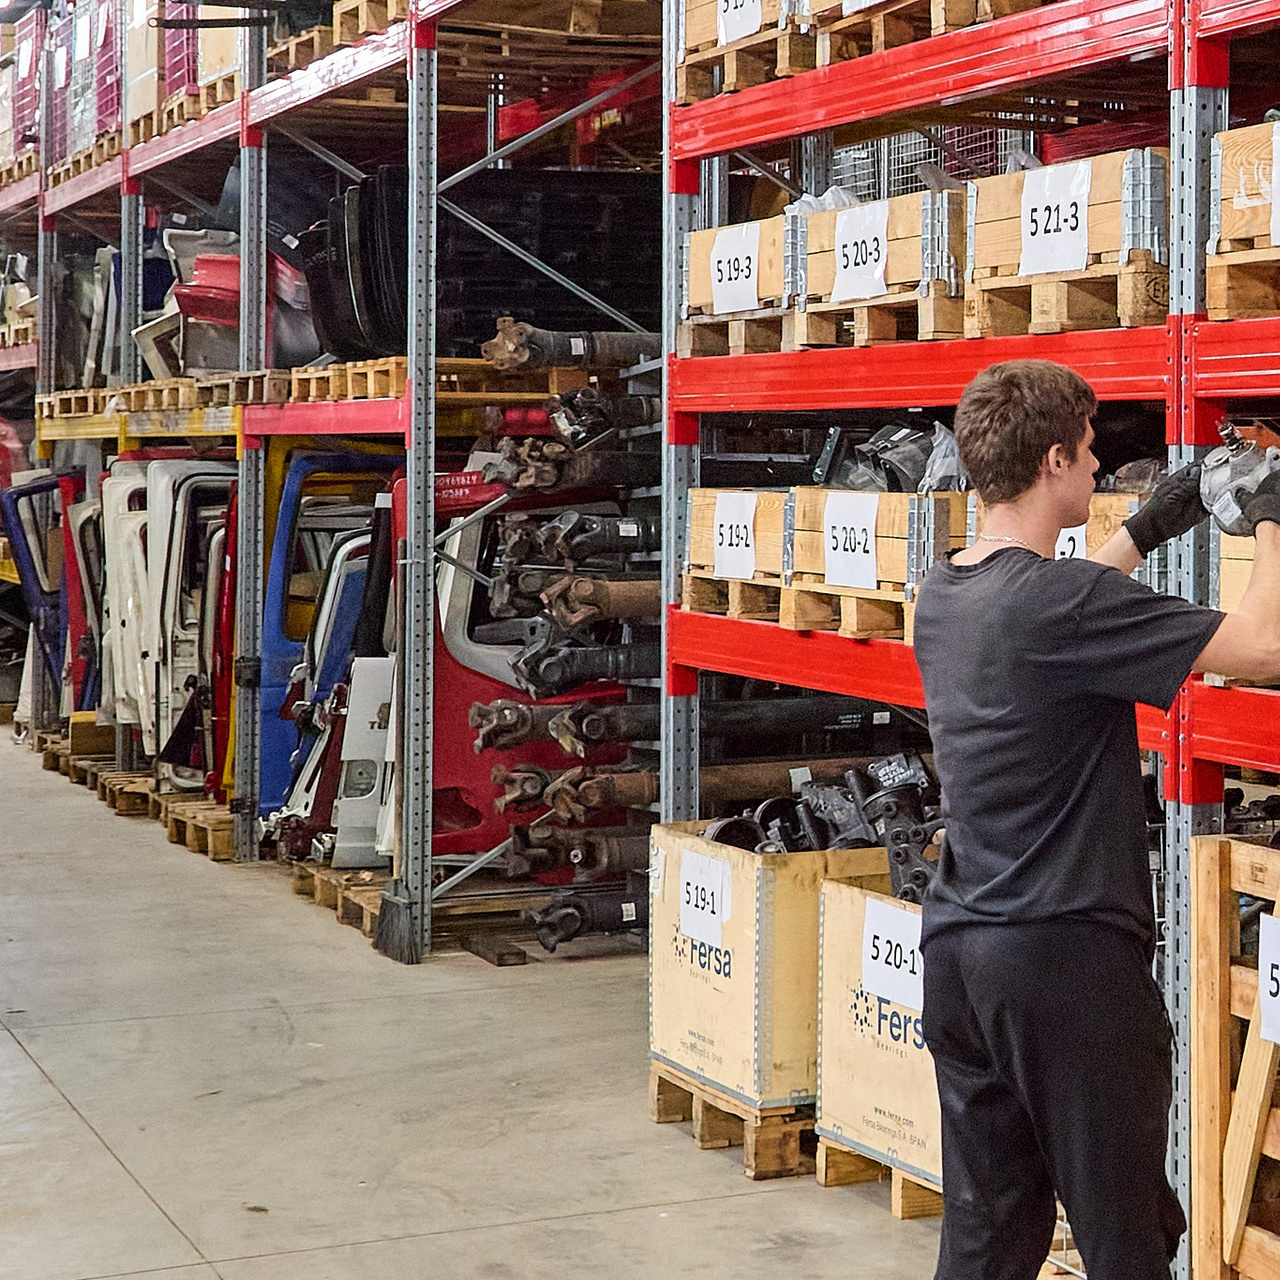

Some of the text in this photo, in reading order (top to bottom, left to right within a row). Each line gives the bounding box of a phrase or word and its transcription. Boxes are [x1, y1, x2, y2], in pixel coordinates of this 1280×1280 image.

[1030, 201, 1079, 237] 5 21-3
[716, 255, 752, 284] 5 19-3
[842, 236, 881, 270] 5 20-3
[718, 523, 751, 549] 5 19-2
[831, 525, 870, 555] 5 20-2
[685, 881, 717, 916] 5 19-1
[690, 938, 732, 979] Fersa
[870, 934, 918, 976] 5 20-1
[1268, 962, 1280, 998] 5
[877, 996, 926, 1050] Fers
